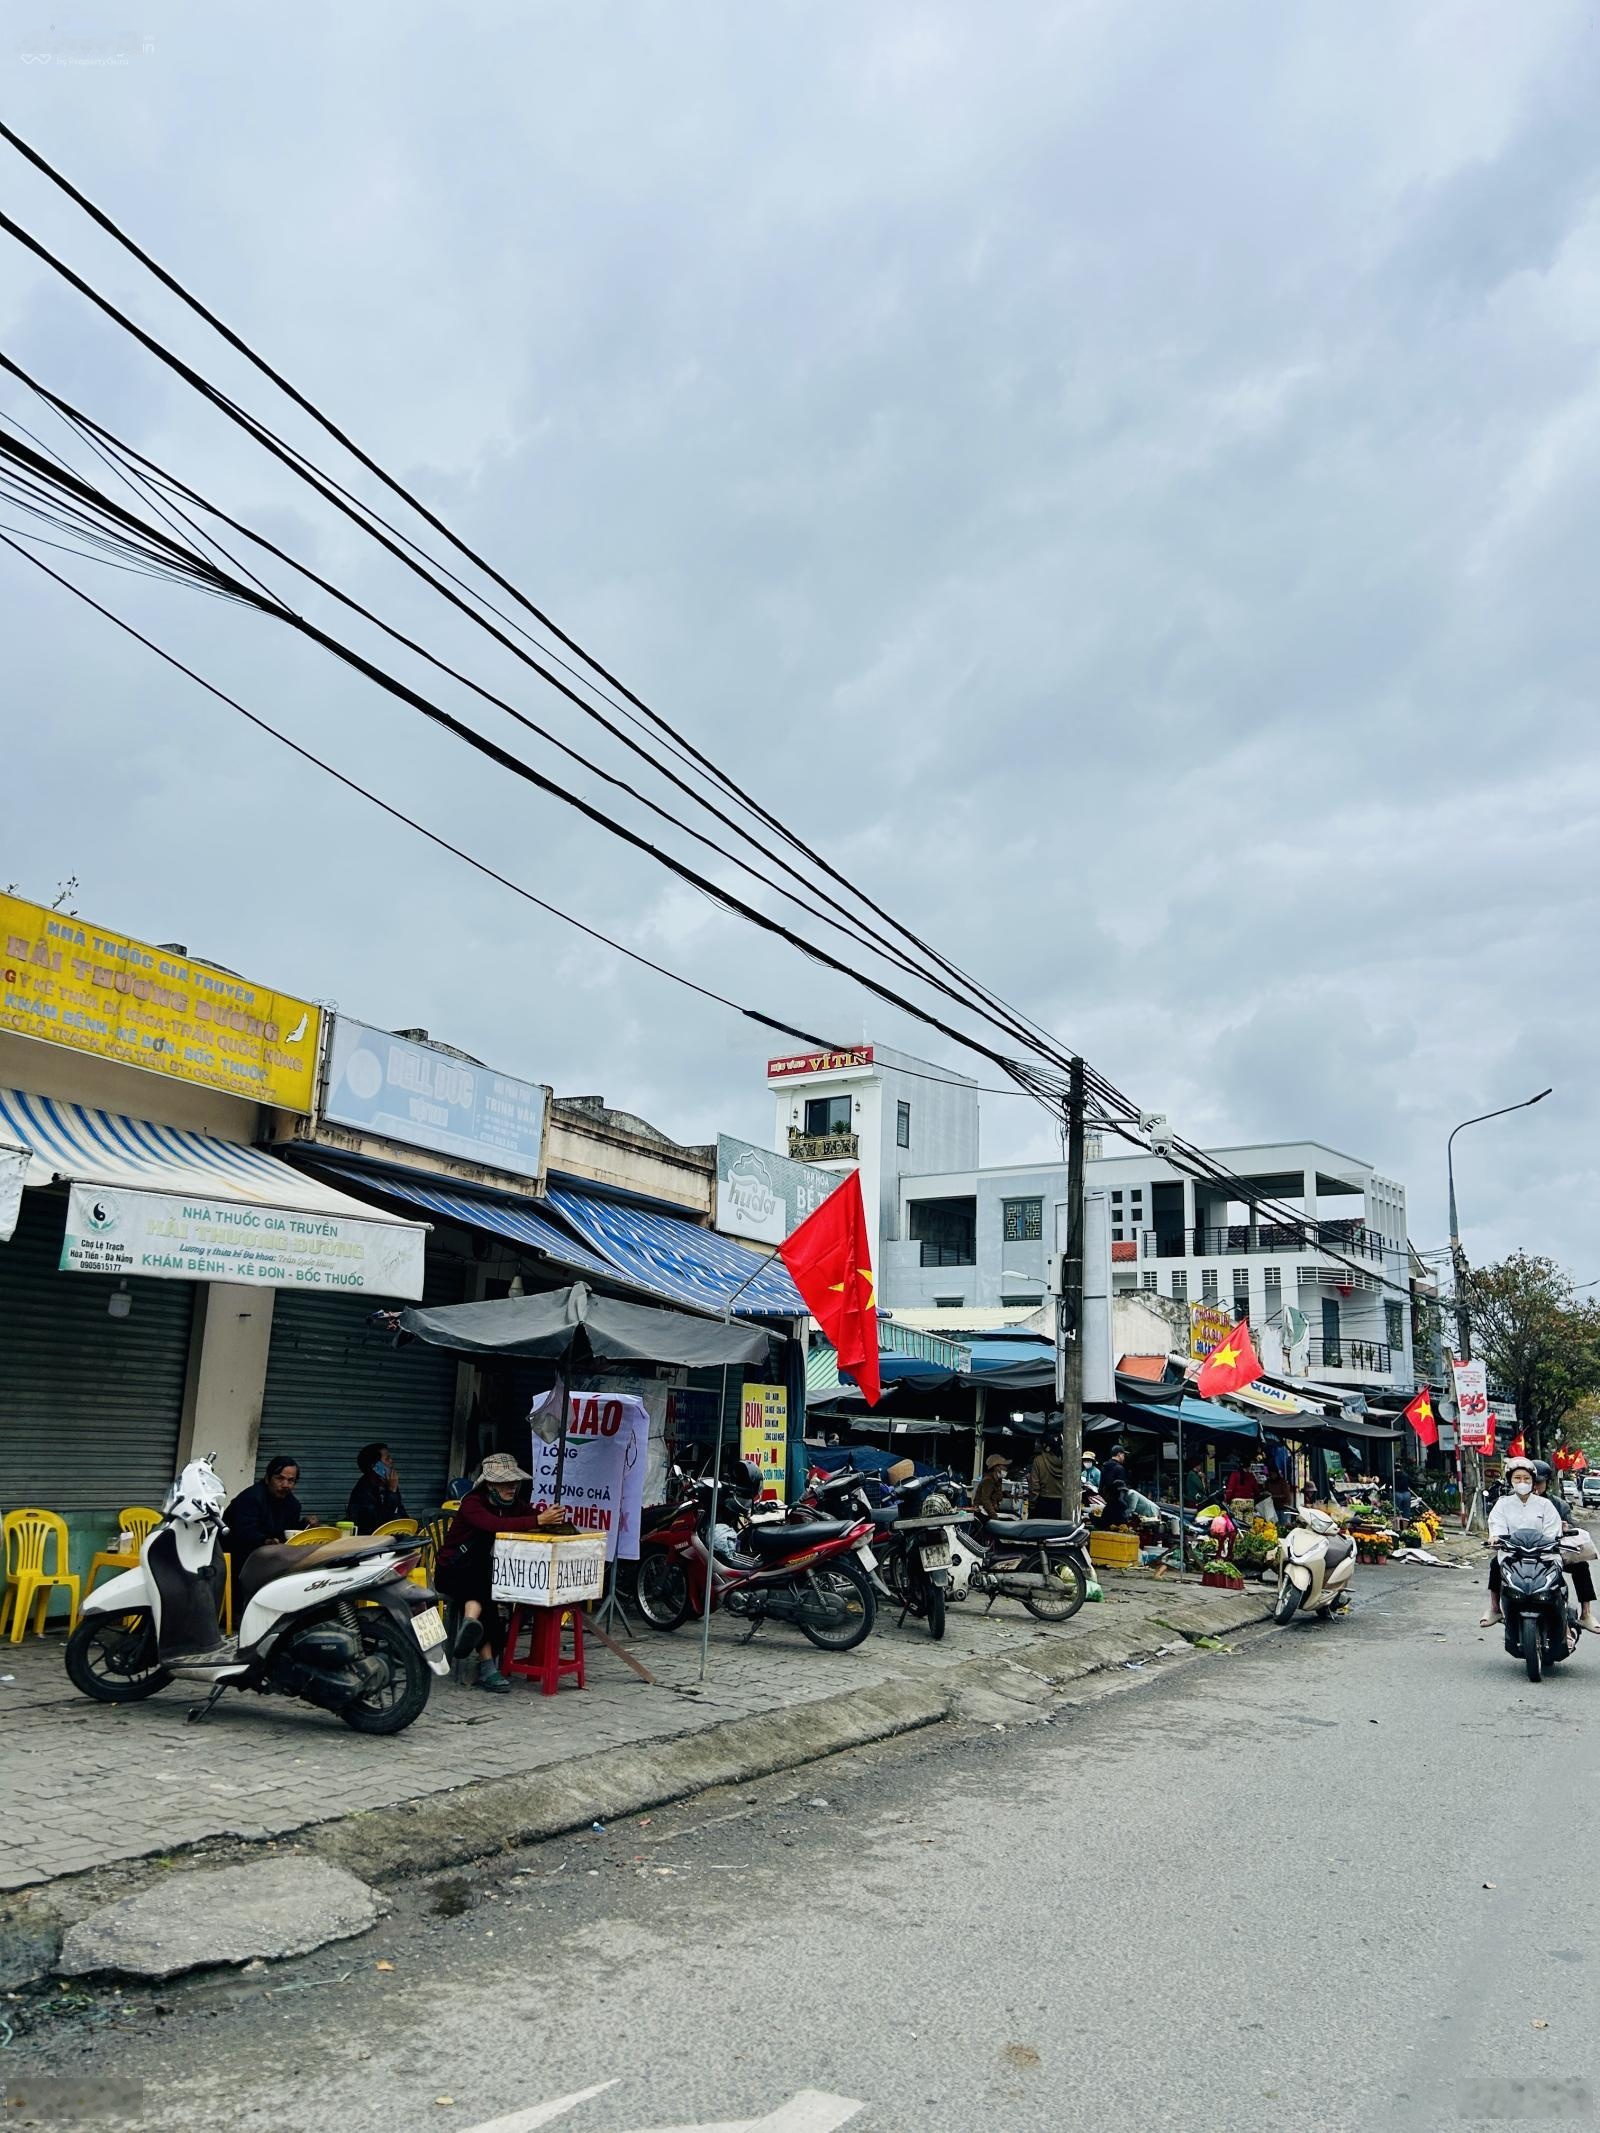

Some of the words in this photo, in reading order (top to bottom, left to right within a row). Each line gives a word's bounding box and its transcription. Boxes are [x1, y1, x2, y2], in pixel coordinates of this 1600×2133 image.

[159, 959, 187, 981] GIA
[182, 1206, 211, 1221] NHÀ
[215, 1208, 262, 1227] THUỐC
[264, 1218, 286, 1230] GIA
[80, 1238, 95, 1249] Chợ
[94, 1239, 104, 1250] Lệ
[79, 1260, 121, 1271] 0905615177
[141, 1253, 184, 1268] KHÁM
[187, 1257, 224, 1273] BỆNH
[259, 1265, 285, 1278] ĐƠN
[296, 1265, 321, 1282] BỐC
[324, 1268, 364, 1286] THUỐC
[744, 1397, 763, 1429] BÚN
[587, 1485, 611, 1501] CHẢ
